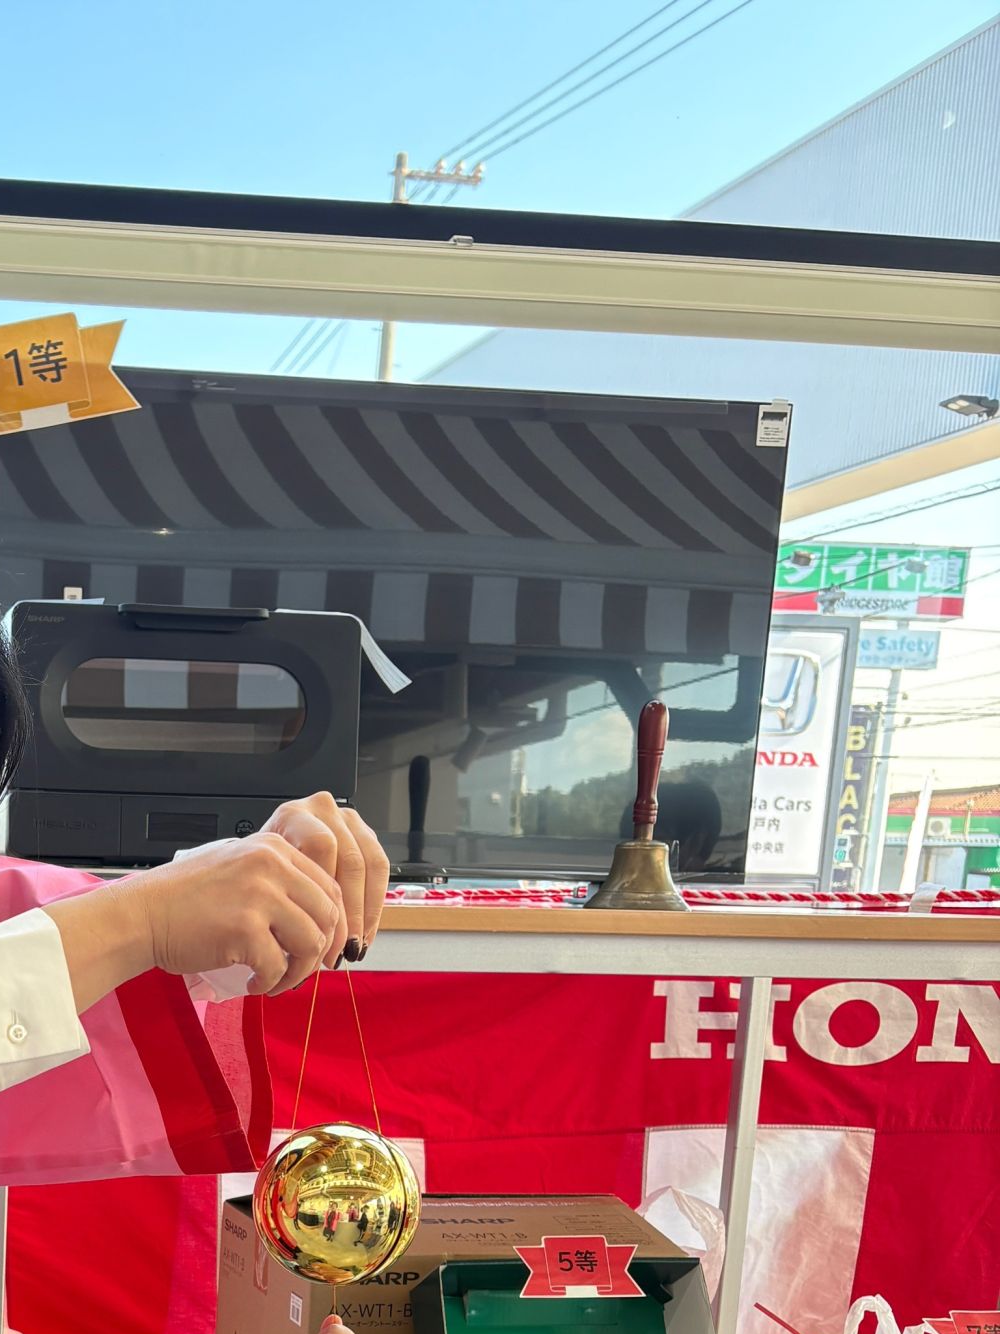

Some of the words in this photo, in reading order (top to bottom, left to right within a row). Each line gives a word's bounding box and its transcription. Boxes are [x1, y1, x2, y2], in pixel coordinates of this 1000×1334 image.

[4, 340, 67, 385] 1等
[877, 636, 934, 655] Safety
[774, 796, 812, 812] Cars
[225, 1219, 248, 1240] SHARP
[557, 1250, 598, 1274] 5等
[358, 1272, 420, 1286] ARP
